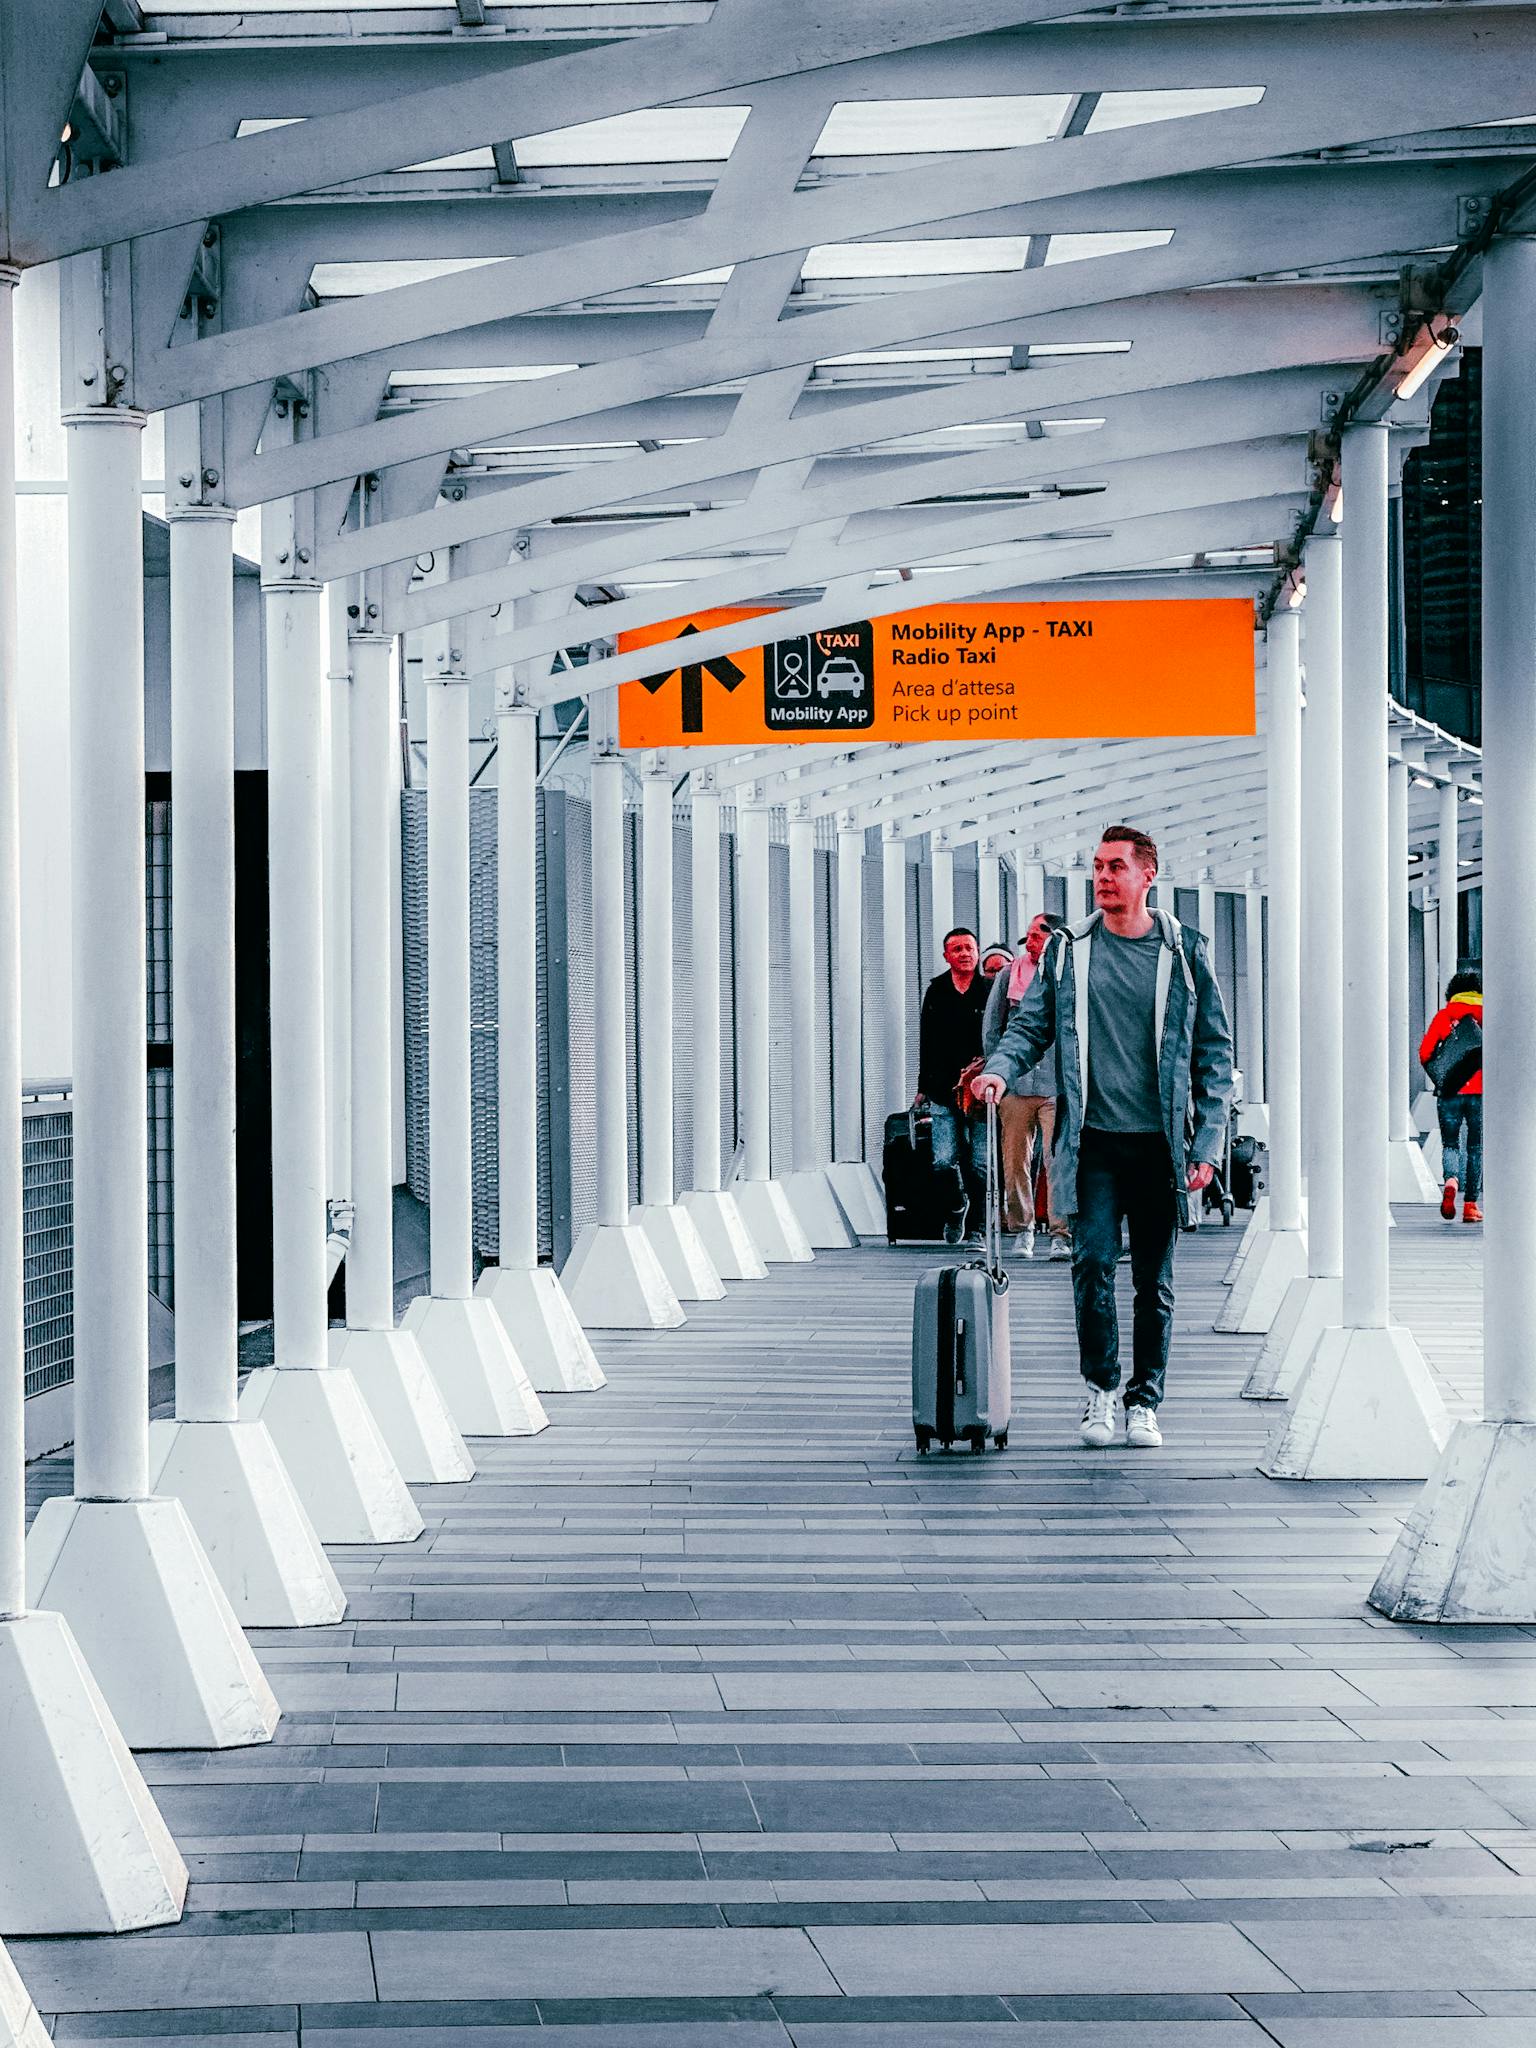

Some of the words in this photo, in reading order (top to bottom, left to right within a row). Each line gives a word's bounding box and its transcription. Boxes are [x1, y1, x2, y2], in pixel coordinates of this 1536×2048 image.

[823, 634, 860, 647] TAXI
[891, 622, 977, 644] Mobility
[983, 622, 1025, 643] App
[1045, 620, 1093, 637] TAXI
[891, 648, 950, 665] Radio
[956, 646, 996, 664] Taxi
[892, 680, 935, 697] Area
[770, 706, 834, 723] Mobility
[836, 706, 868, 723] App
[893, 704, 930, 722] Pick
[937, 707, 961, 725] up
[968, 703, 1018, 725] point
